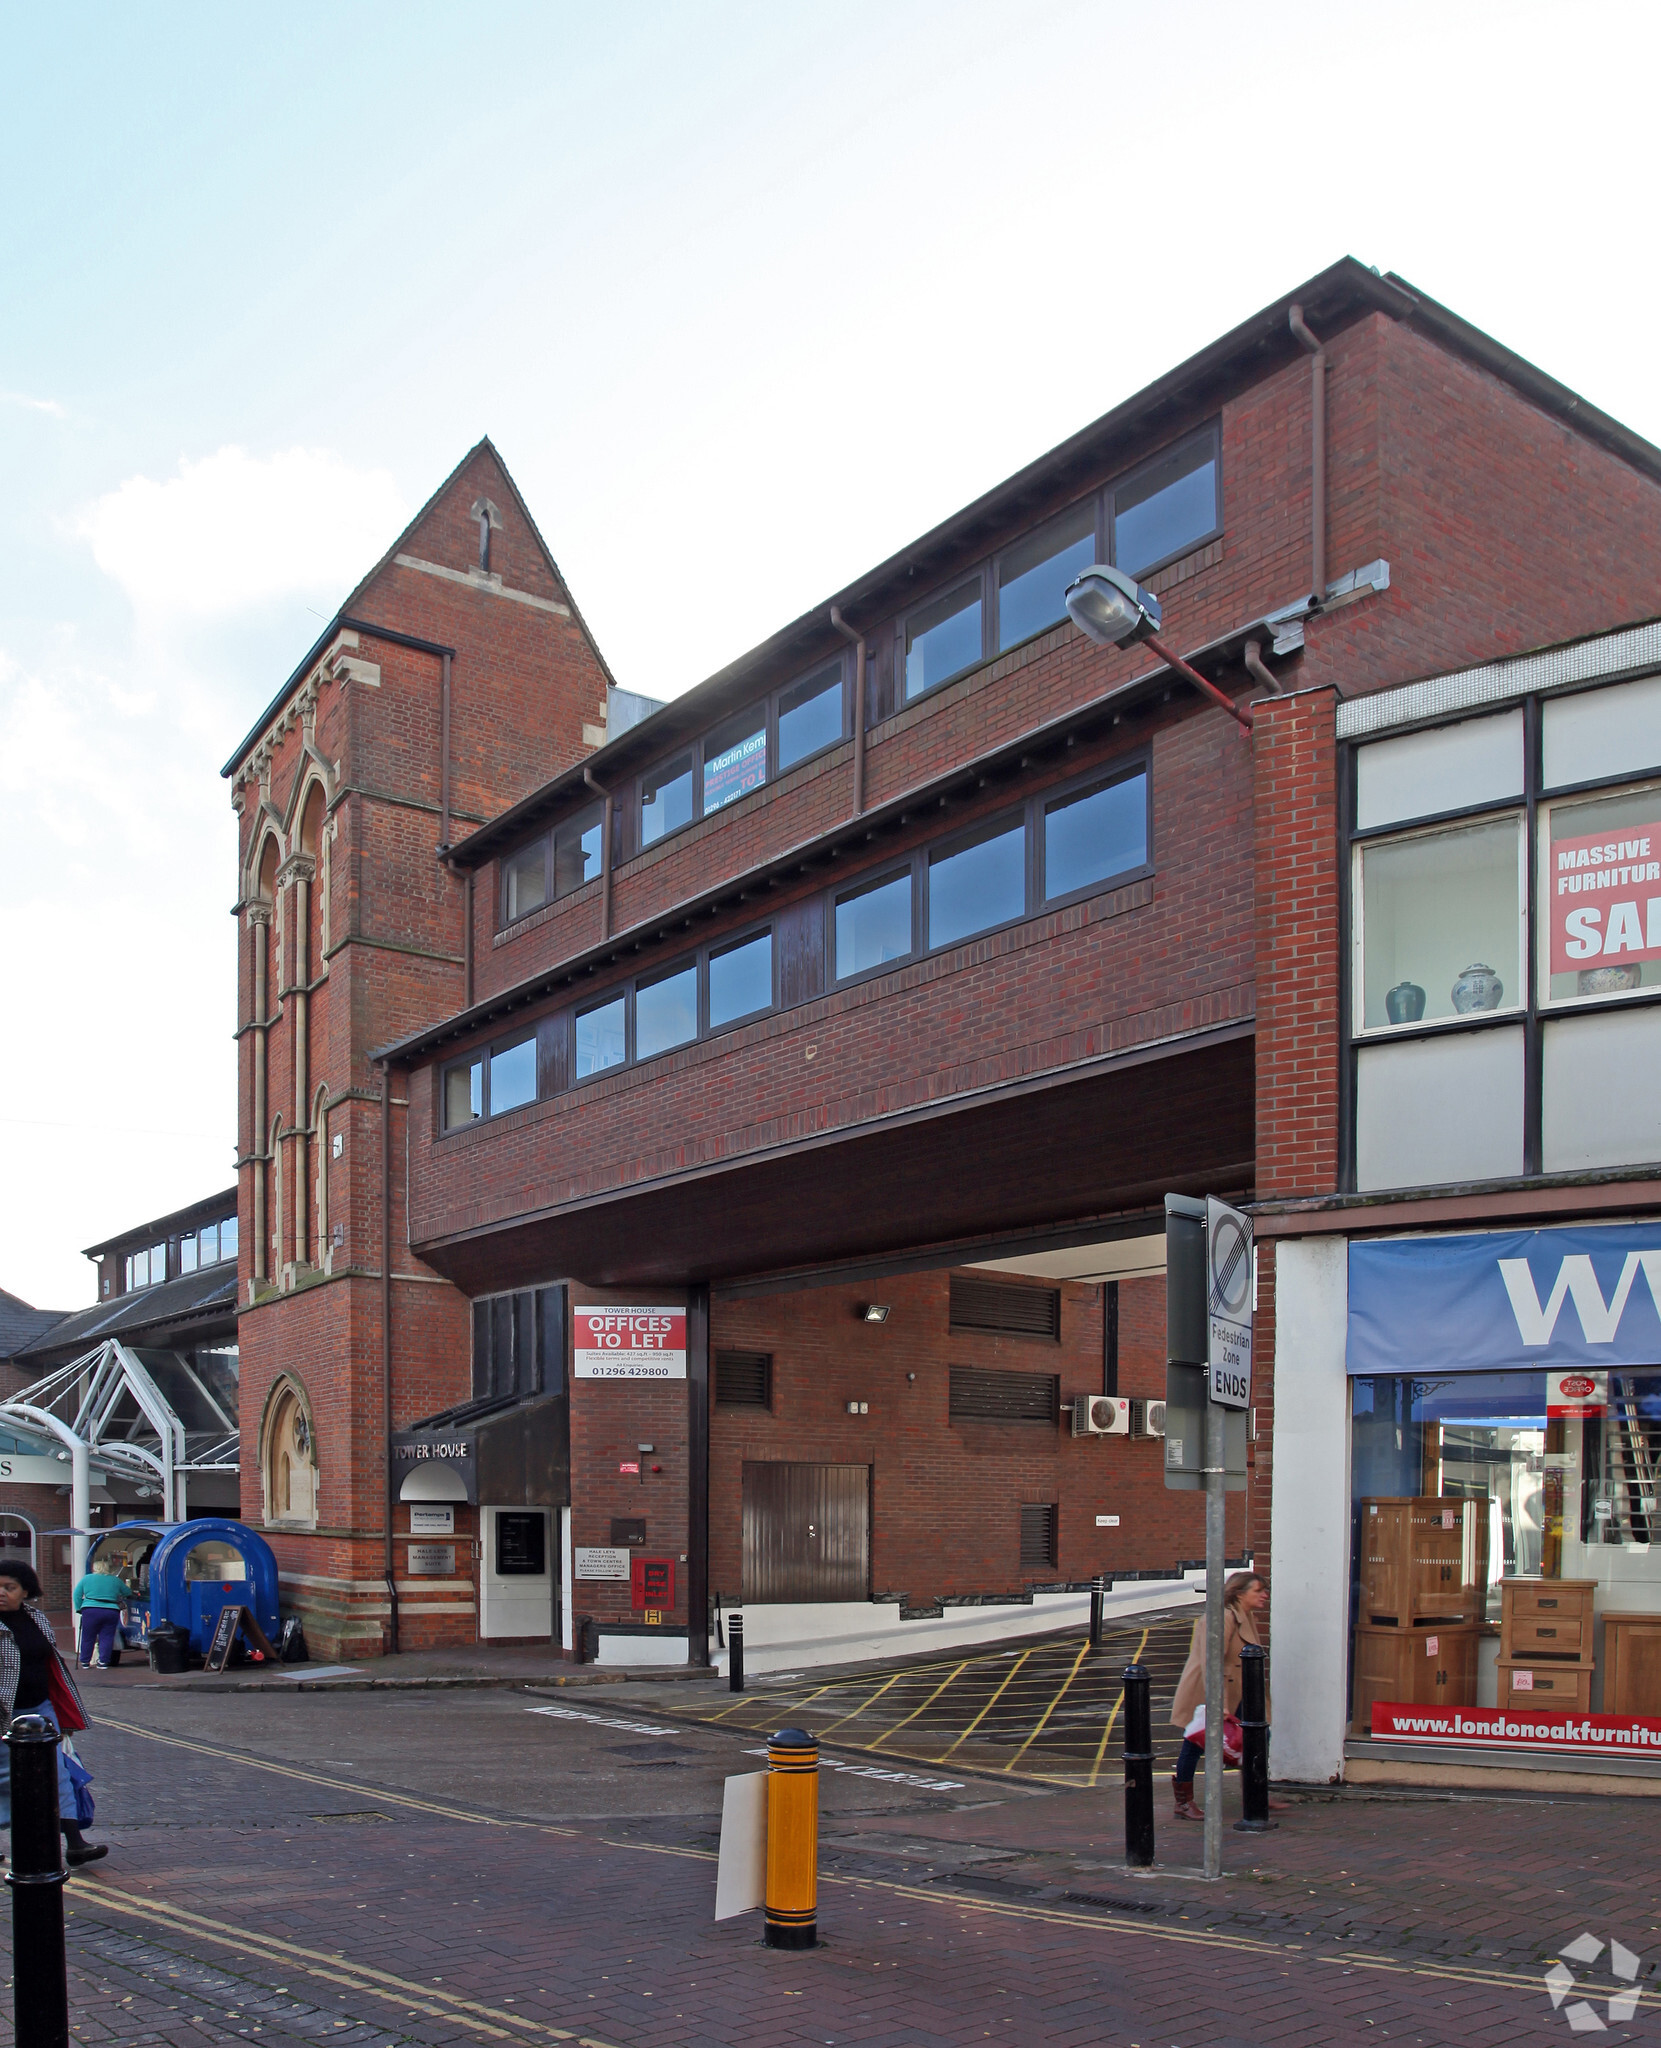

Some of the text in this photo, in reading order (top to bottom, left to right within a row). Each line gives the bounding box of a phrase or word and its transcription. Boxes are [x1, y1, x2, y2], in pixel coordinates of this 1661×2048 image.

[713, 750, 742, 773] Martin
[741, 773, 756, 789] TO
[1558, 838, 1650, 871] MASSIVE
[588, 1316, 672, 1331] OFFICES
[593, 1333, 667, 1348] TO LET
[1222, 1347, 1240, 1366] Zone
[592, 1367, 669, 1376] 01296 429800
[1215, 1370, 1247, 1399] ENDS
[394, 1442, 467, 1459] TOWER HOUSE
[1, 1461, 12, 1476] S
